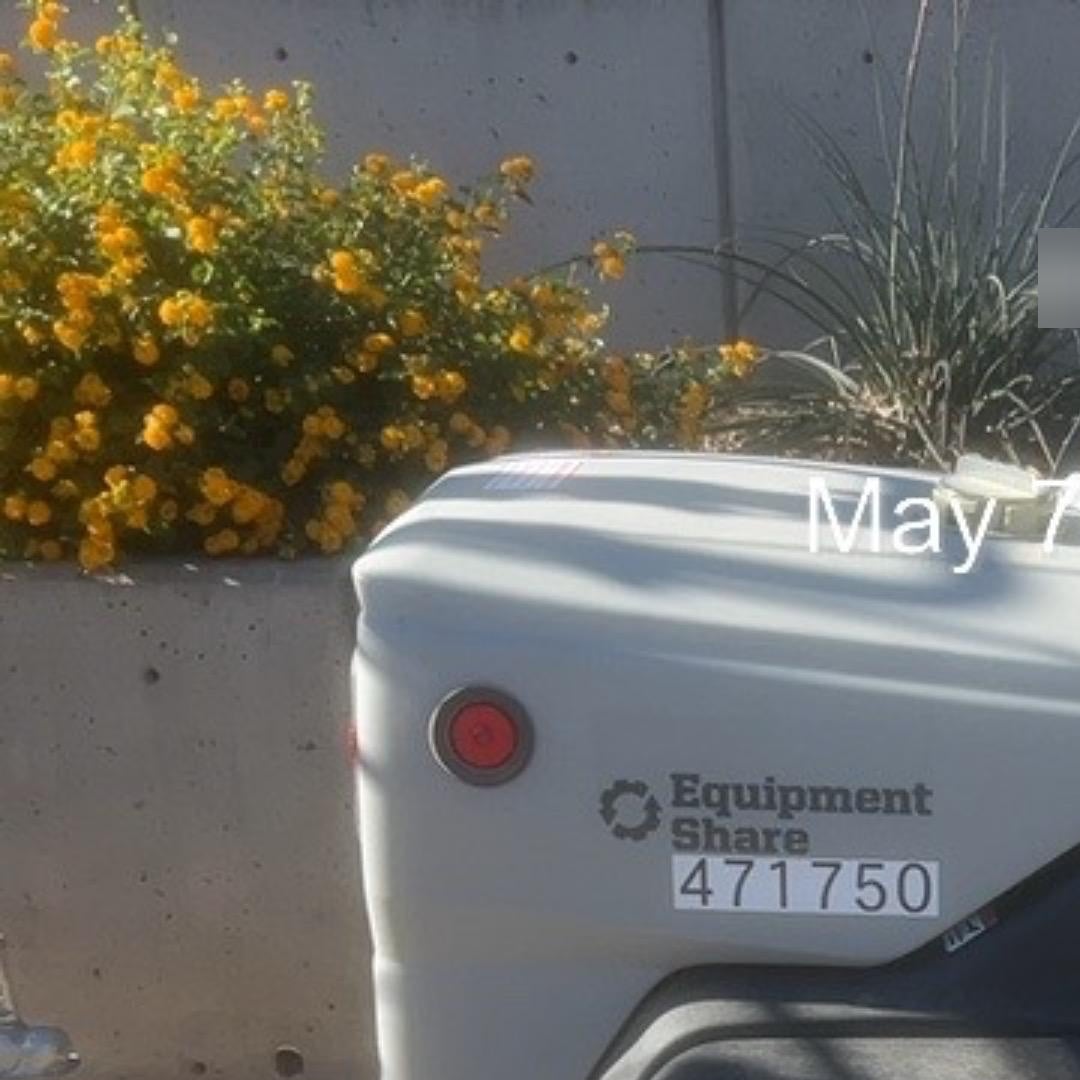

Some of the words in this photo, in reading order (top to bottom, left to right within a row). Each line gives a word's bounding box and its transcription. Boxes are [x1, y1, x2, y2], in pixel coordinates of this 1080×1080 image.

[670, 773, 933, 819] Equipment
[671, 817, 810, 855] Share
[680, 858, 932, 913] 471750
